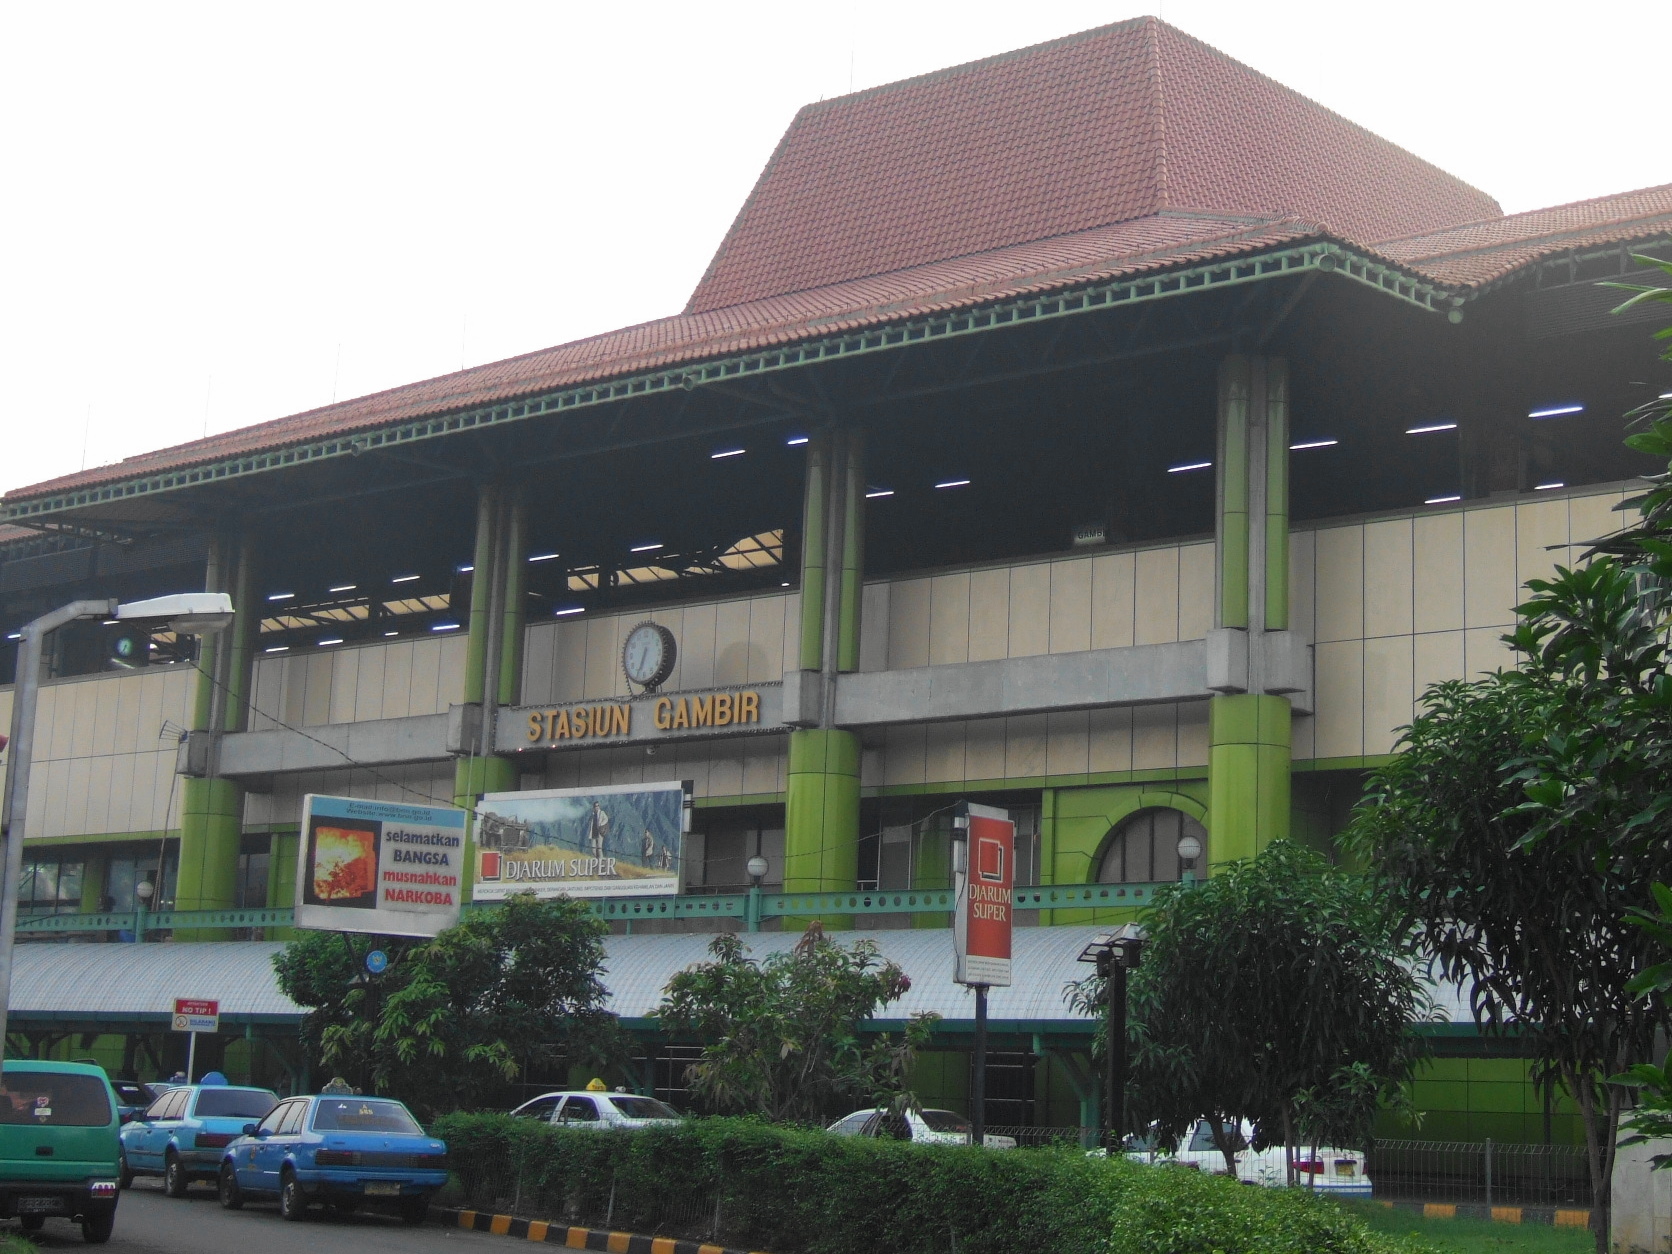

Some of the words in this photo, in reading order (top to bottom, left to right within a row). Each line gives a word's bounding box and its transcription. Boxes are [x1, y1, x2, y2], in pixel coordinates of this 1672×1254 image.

[527, 704, 631, 742] STASIUN
[653, 691, 759, 730] GAMBIR
[386, 830, 460, 847] selamatkan
[393, 849, 449, 866] BANGSA
[506, 859, 565, 880] DJARUM
[569, 857, 617, 877] SUPER
[383, 871, 457, 887] musnahkan
[385, 888, 453, 905] NARKOBA
[970, 884, 1010, 903] DJARUM
[974, 904, 1006, 921] SUPER
